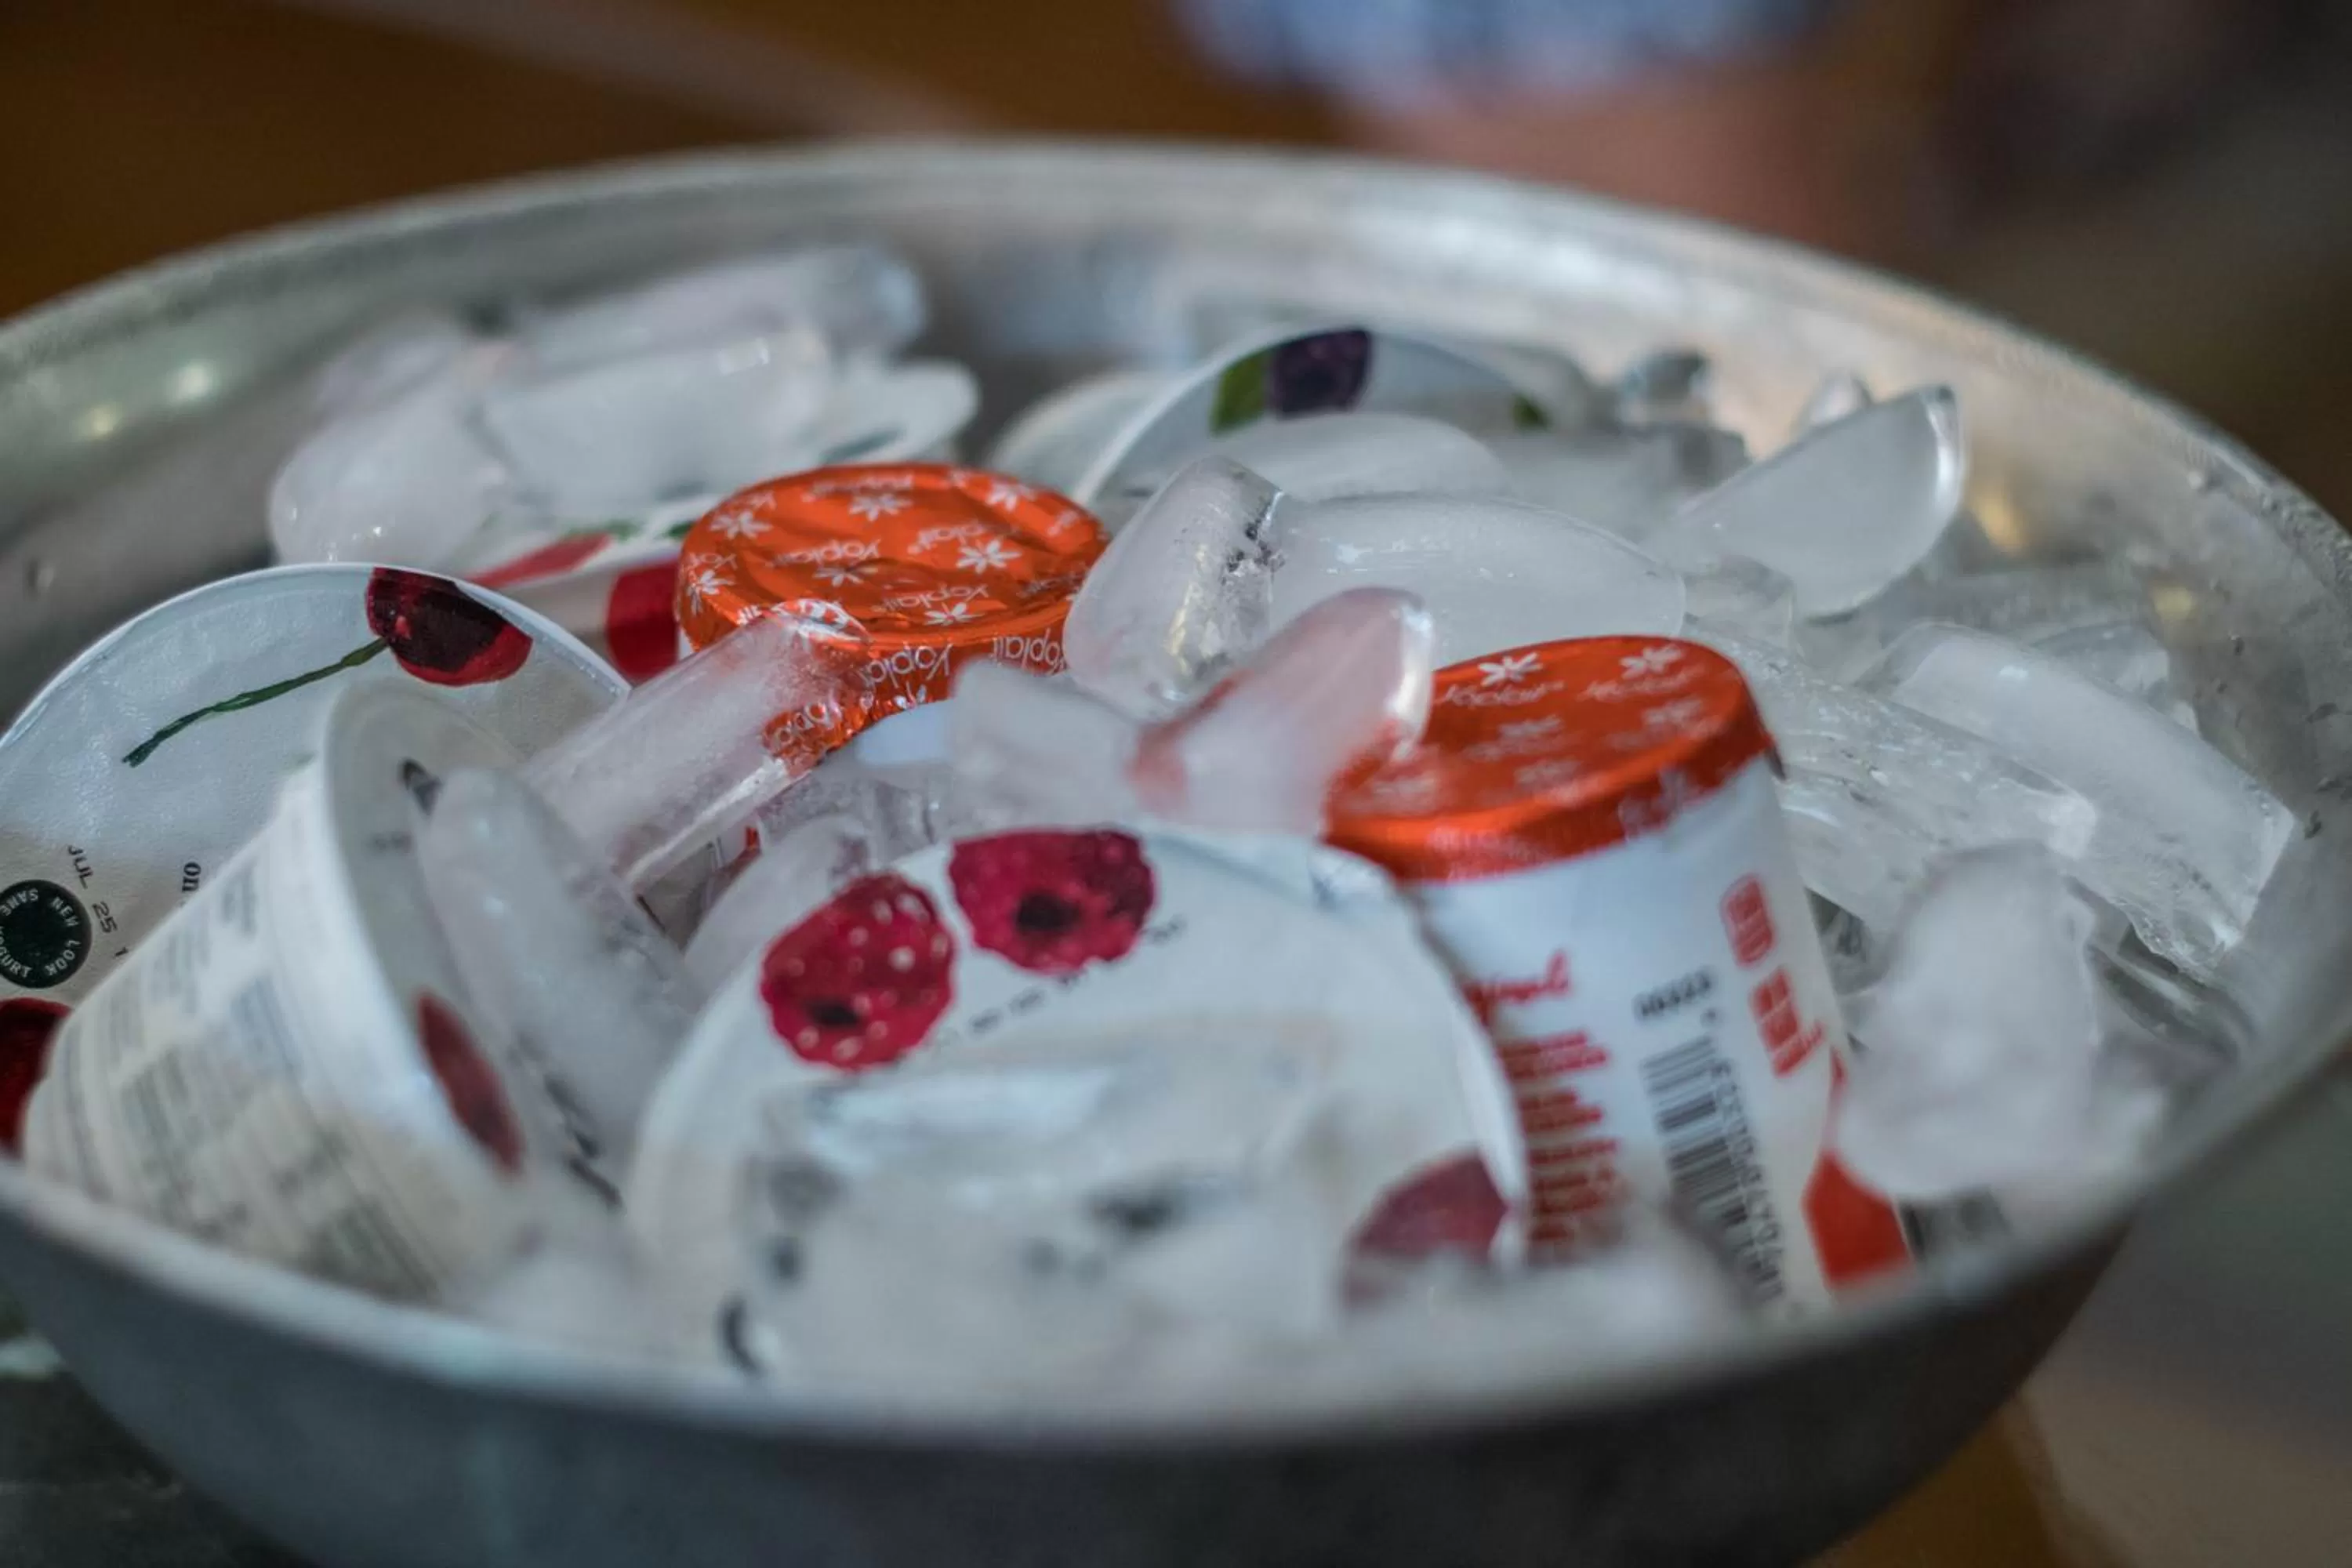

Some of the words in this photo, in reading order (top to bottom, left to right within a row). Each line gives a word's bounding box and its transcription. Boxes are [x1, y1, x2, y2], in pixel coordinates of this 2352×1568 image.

[67, 845, 93, 890] JUL
[92, 902, 118, 934] 25
[181, 861, 202, 893] on
[49, 895, 80, 927] NEW
[43, 938, 82, 976] LOOK
